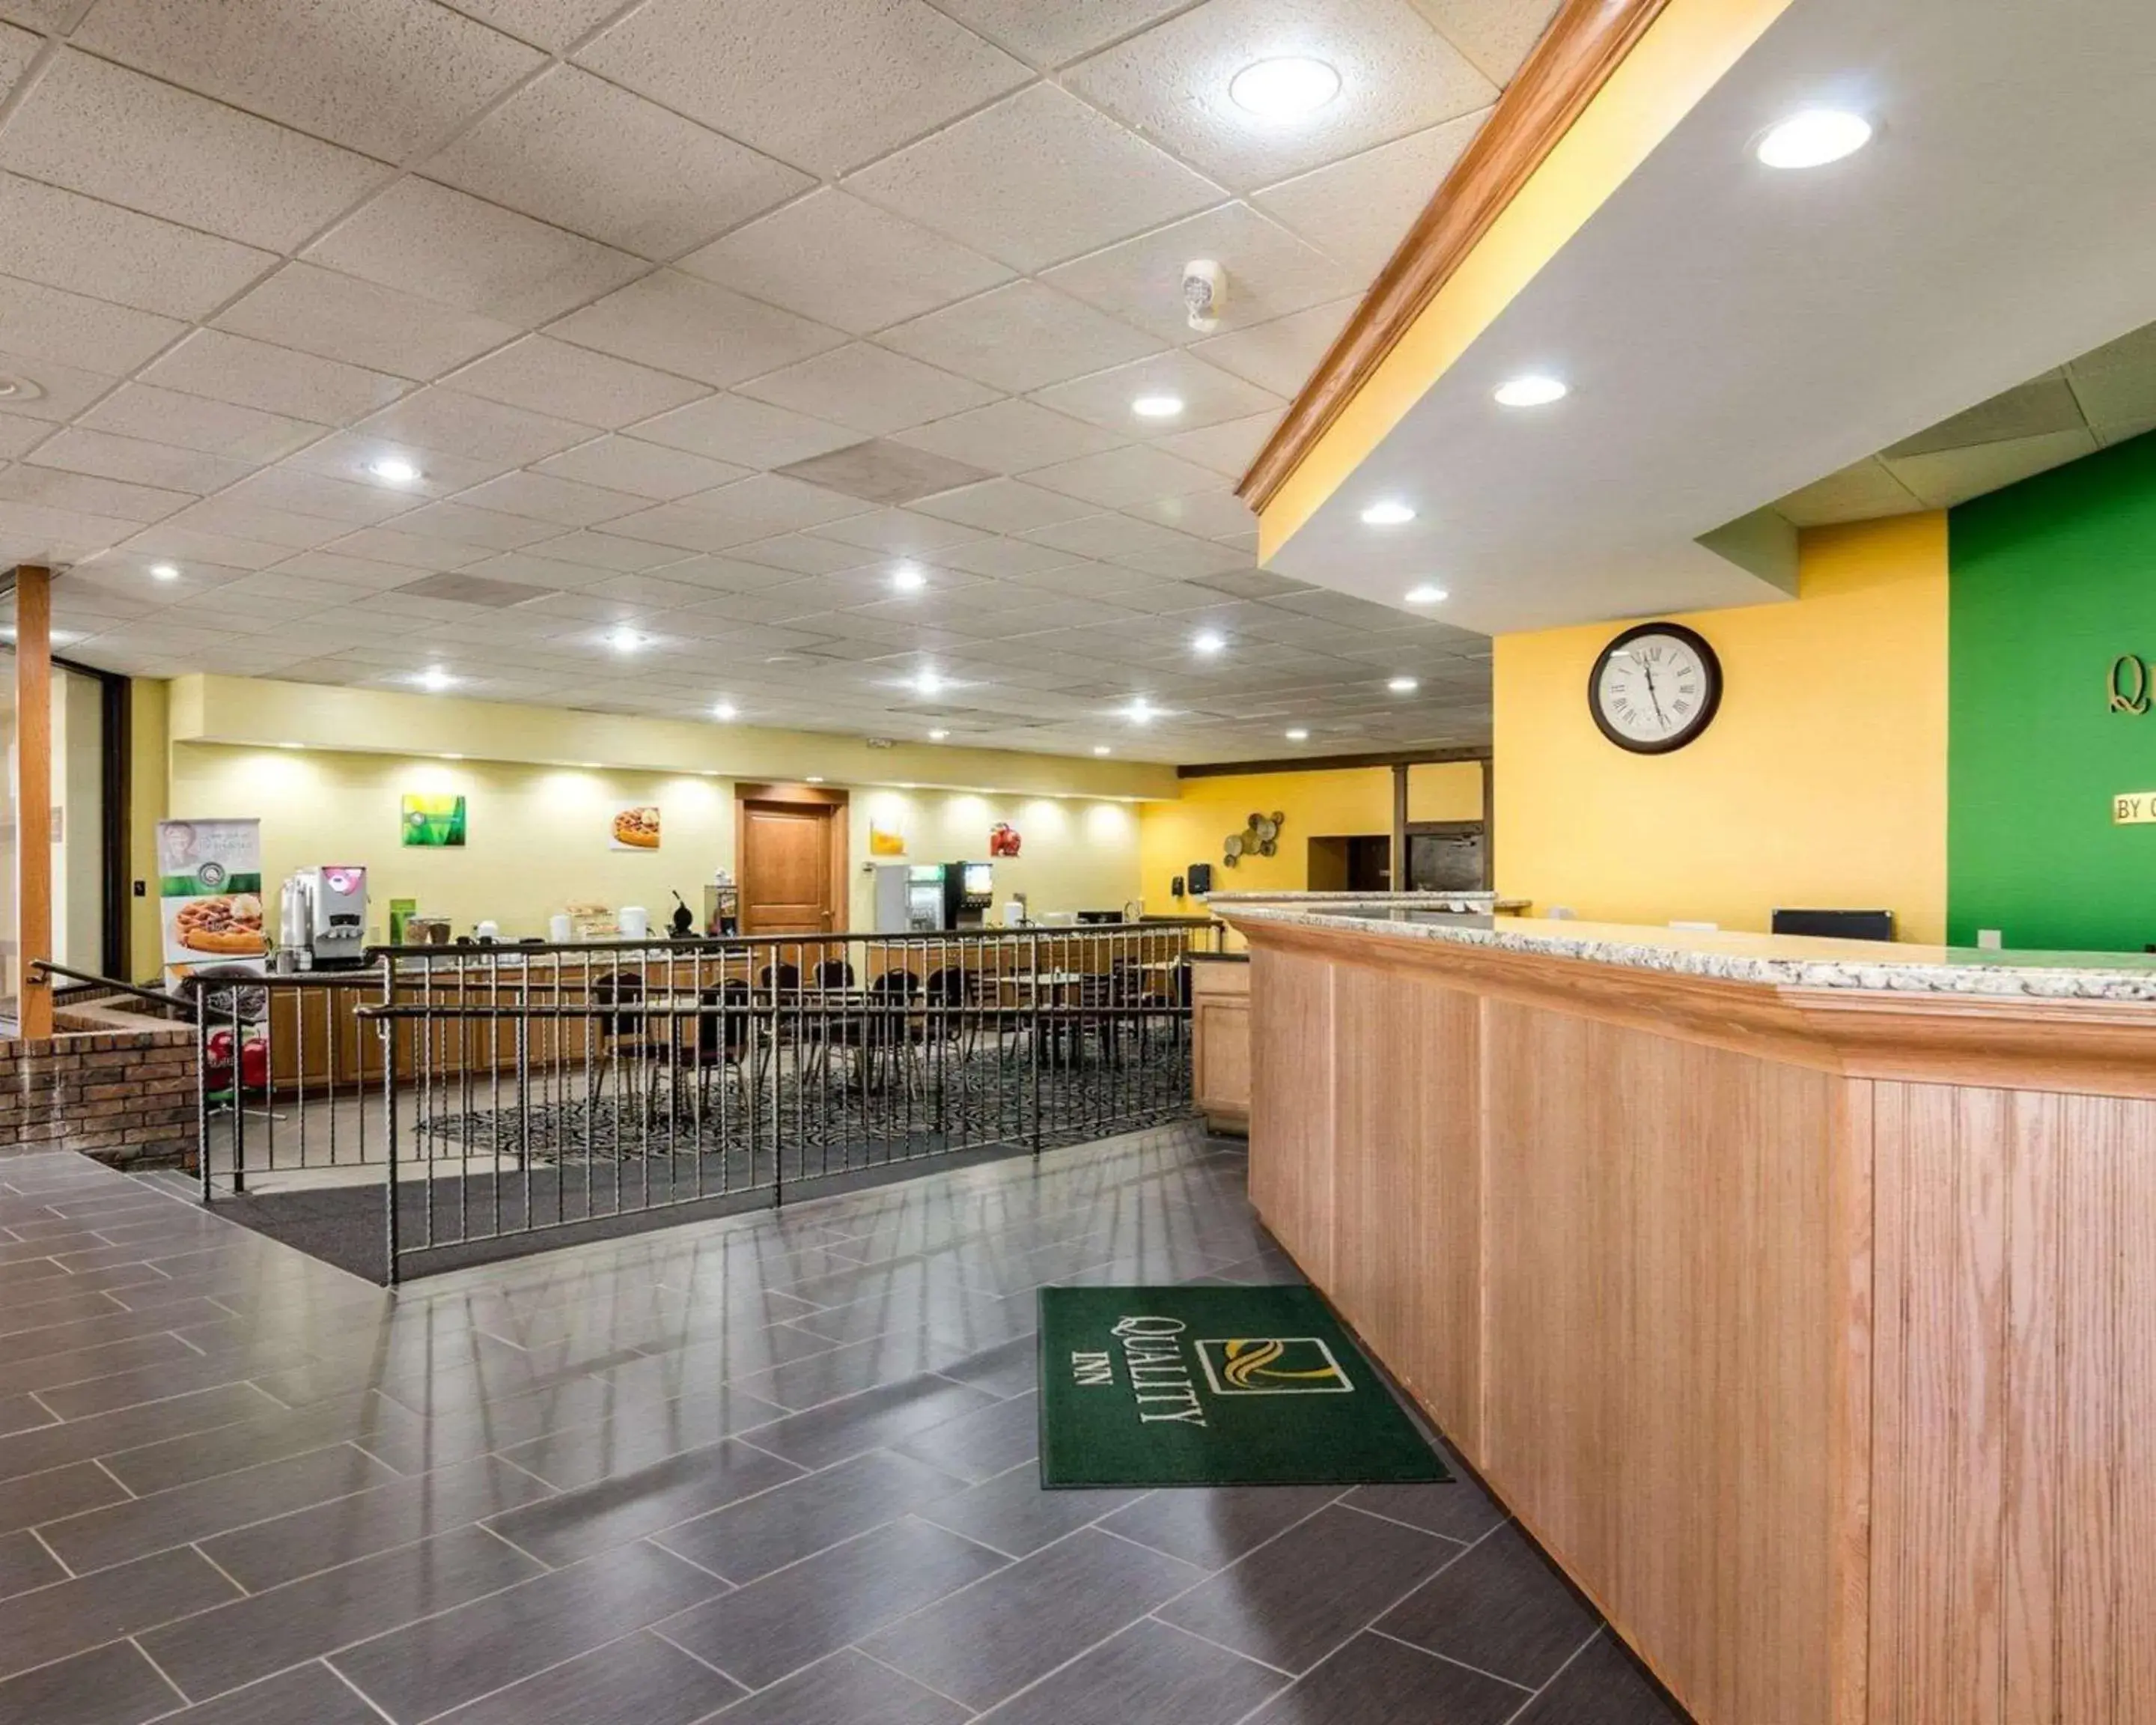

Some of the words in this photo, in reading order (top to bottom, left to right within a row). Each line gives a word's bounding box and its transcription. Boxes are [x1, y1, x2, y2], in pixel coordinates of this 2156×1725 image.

[2118, 798, 2140, 819] BY
[1071, 1350, 1114, 1385] INN
[1110, 1315, 1208, 1427] QUALITY
